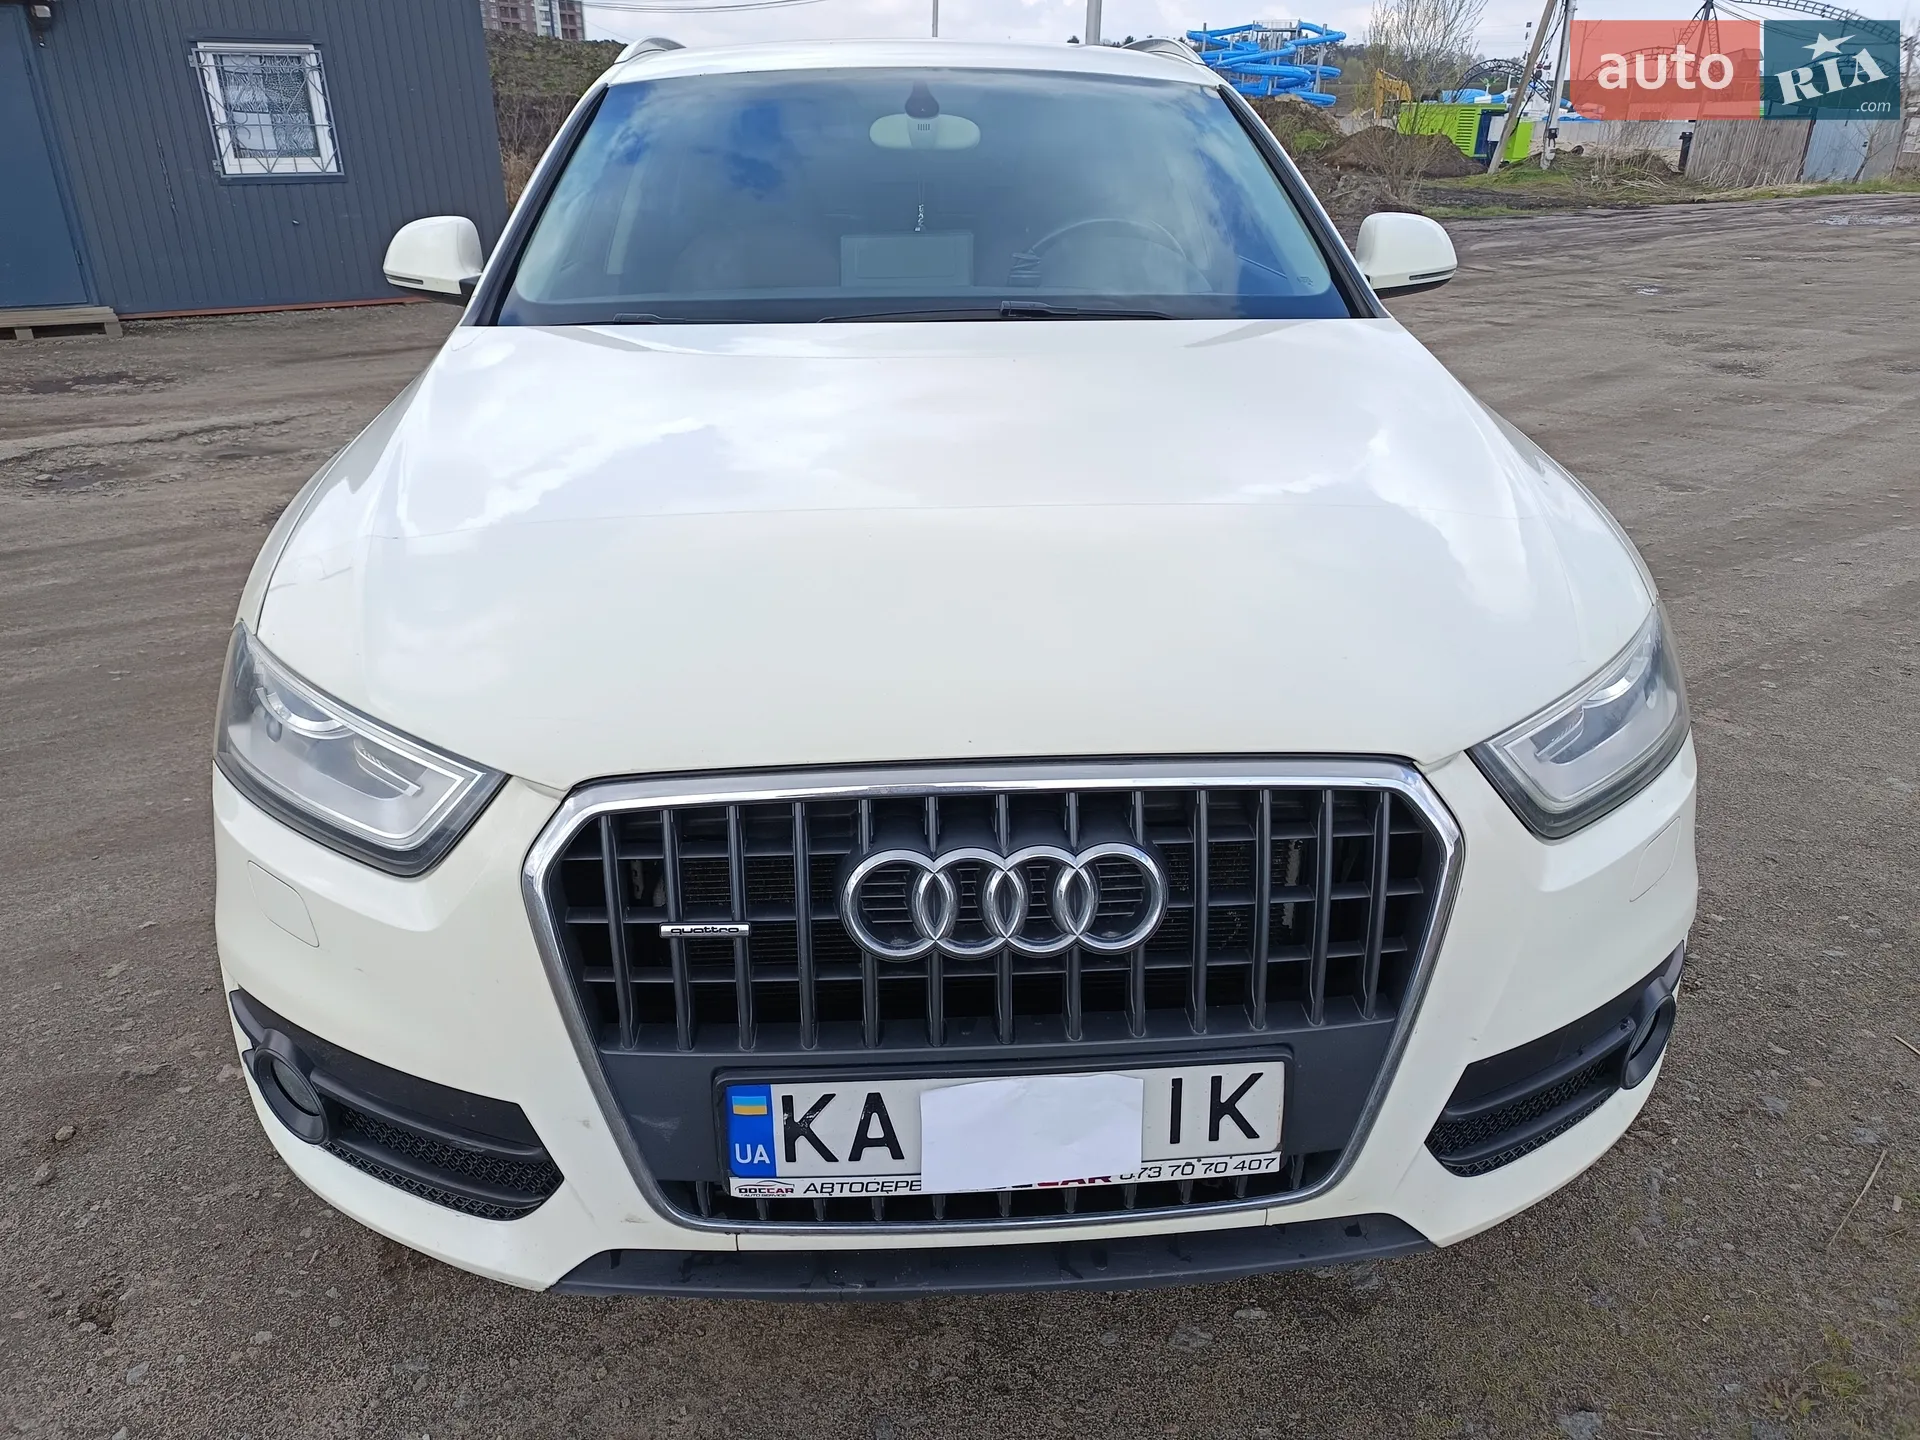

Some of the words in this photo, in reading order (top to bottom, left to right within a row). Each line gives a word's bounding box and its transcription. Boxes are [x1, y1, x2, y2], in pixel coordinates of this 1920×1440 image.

[670, 926, 740, 936] quattro
[780, 1092, 906, 1163] KA
[1168, 1072, 1265, 1145] IK
[735, 1143, 771, 1165] UA
[1168, 1162, 1195, 1177] 70
[1201, 1161, 1228, 1175] 70
[1232, 1157, 1277, 1171] 407
